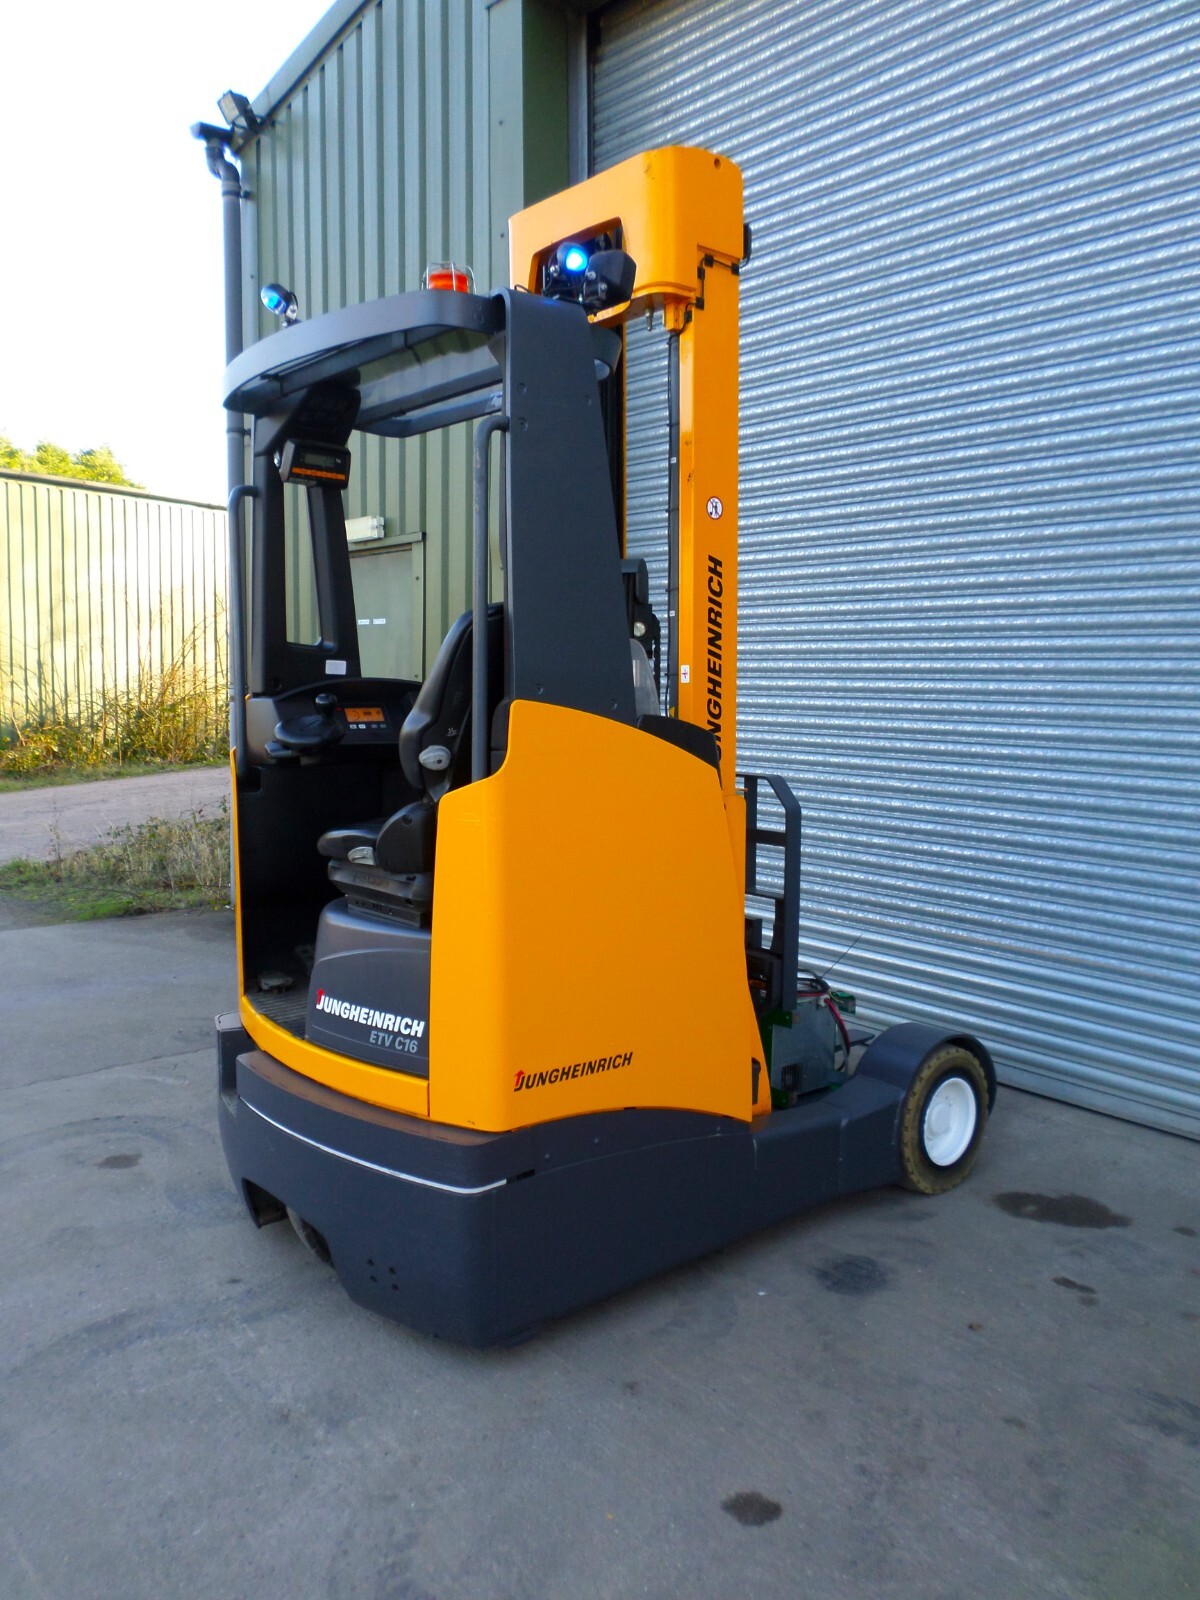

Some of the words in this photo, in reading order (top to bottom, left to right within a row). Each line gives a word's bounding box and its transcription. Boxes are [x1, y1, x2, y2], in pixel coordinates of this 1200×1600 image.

[706, 555, 722, 761] NGHEINRICH
[315, 992, 425, 1038] JUNGHEINRICH
[369, 1030, 393, 1047] ETV
[394, 1036, 418, 1053] C16
[513, 1052, 633, 1092] JUNGHEINRICH
